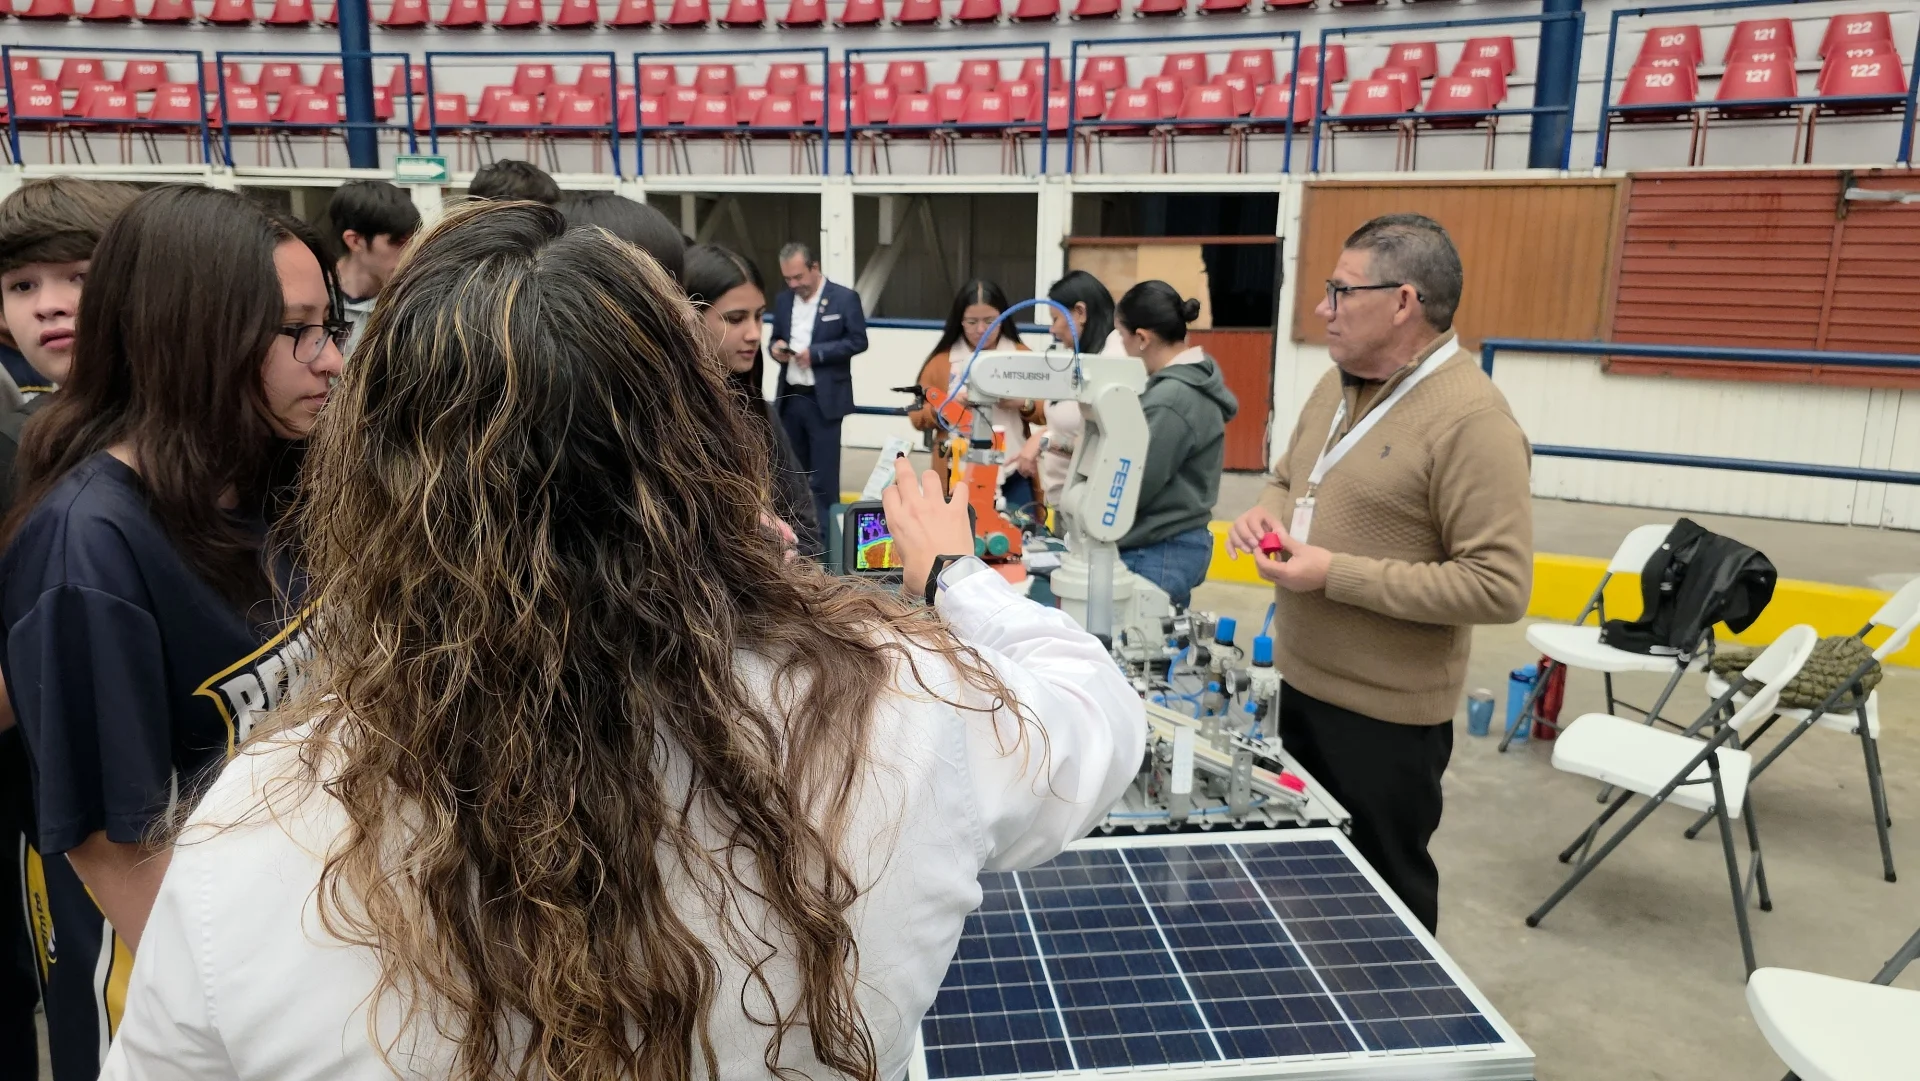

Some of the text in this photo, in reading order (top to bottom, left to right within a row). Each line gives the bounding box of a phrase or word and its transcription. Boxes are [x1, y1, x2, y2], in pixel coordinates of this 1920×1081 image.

[1753, 28, 1777, 41] 121
[1846, 21, 1873, 35] 122
[1660, 33, 1686, 47] 120
[1315, 52, 1333, 63] 17
[1403, 48, 1422, 60] 118
[1479, 45, 1499, 58] 119
[77, 64, 92, 74] 99
[137, 65, 157, 75] 100
[1745, 68, 1771, 83] 121
[1850, 63, 1881, 77] 122
[1645, 73, 1675, 87] 120
[1367, 85, 1389, 98] 118
[1450, 84, 1472, 97] 119
[30, 95, 52, 106] 100
[108, 97, 127, 107] 101
[170, 97, 191, 107] 102
[1003, 371, 1050, 381] MITSUBISHI
[1102, 458, 1132, 527] FESTO
